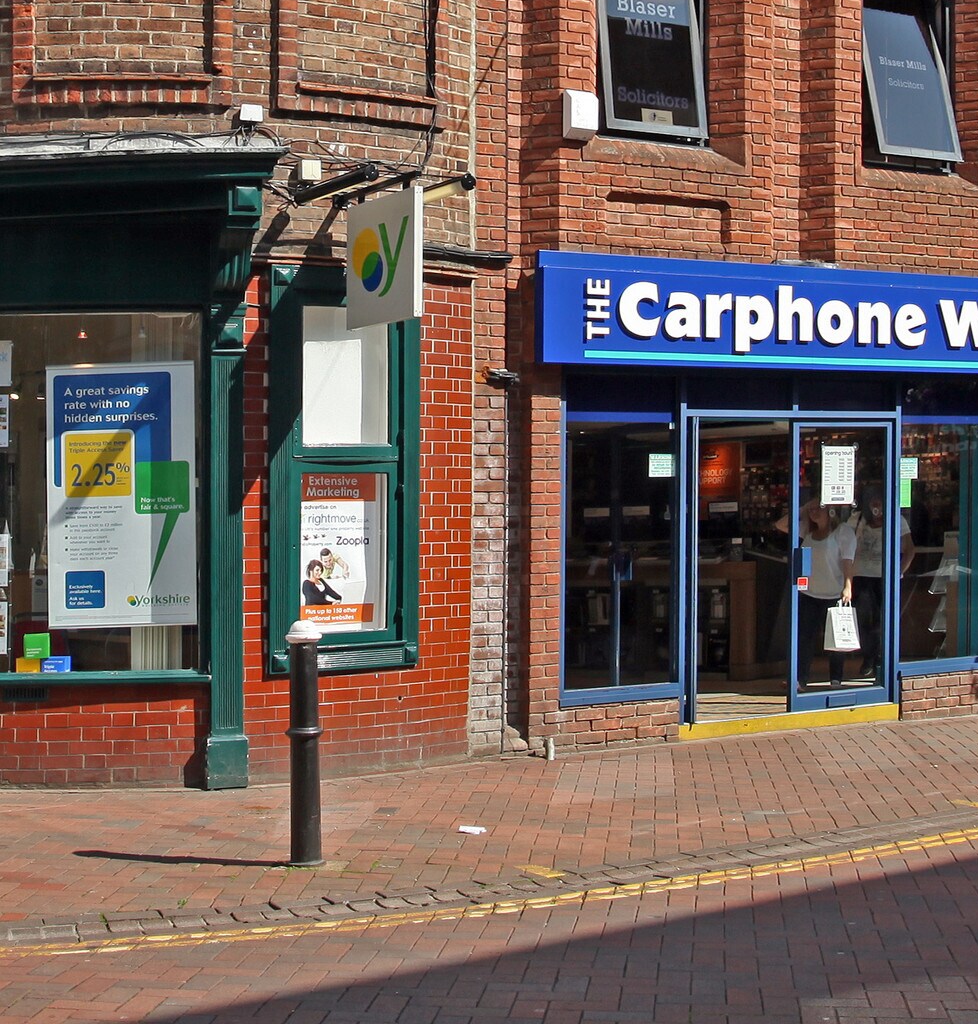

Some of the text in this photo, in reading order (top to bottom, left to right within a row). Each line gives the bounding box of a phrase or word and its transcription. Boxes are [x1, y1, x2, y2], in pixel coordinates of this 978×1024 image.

[624, 16, 673, 41] Mills
[879, 55, 927, 71] Blaser Mills
[617, 85, 689, 110] Solicitors
[586, 277, 611, 341] THE
[618, 281, 928, 353] Carphone
[64, 385, 150, 398] A great savings
[64, 400, 130, 410] rate with no
[64, 412, 158, 423] hidden surprises.
[308, 476, 358, 486] Extensive
[306, 487, 360, 498] Marketing
[336, 536, 370, 547] Zoopla
